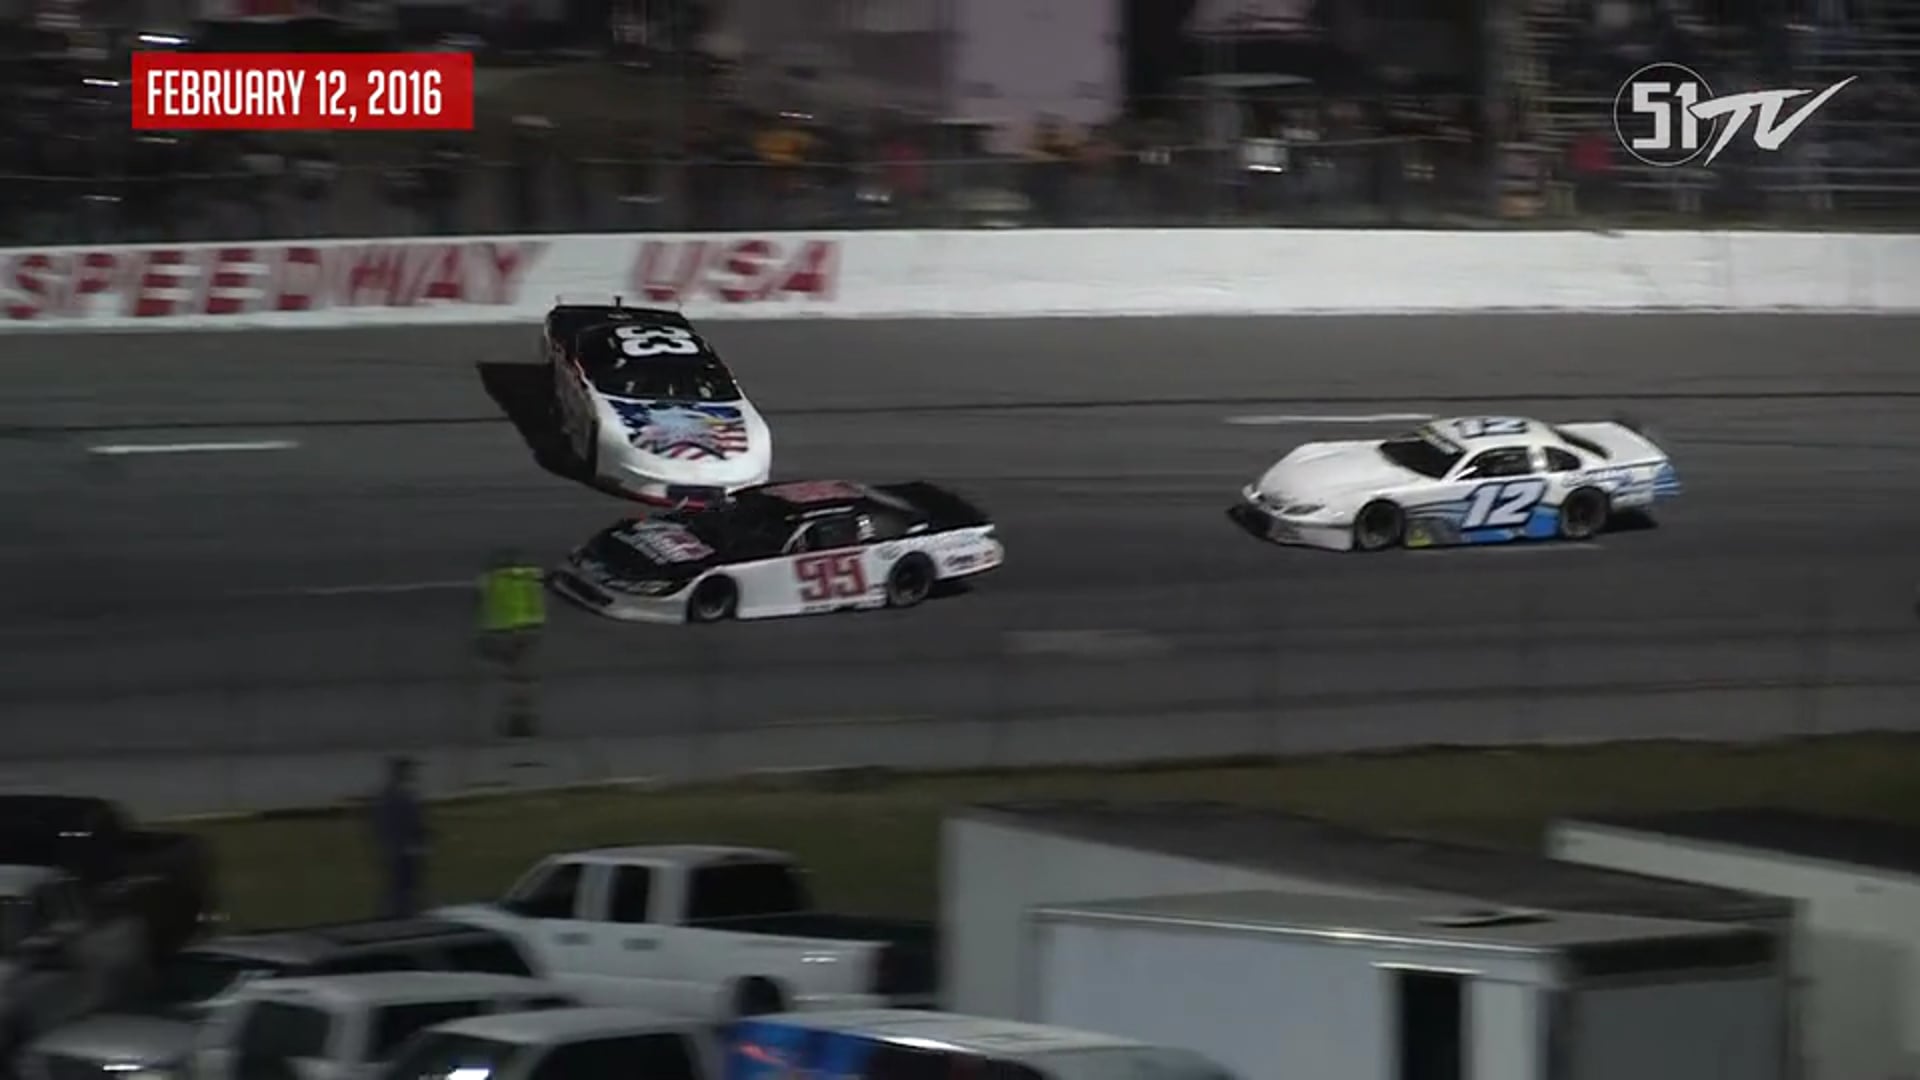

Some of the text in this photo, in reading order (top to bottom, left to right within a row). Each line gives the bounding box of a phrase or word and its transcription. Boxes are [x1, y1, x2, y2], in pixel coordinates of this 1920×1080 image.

[0, 239, 841, 321] SPEEDWAY USA
[614, 324, 699, 358] 33
[1460, 477, 1549, 530] 12
[795, 551, 866, 602] 99
